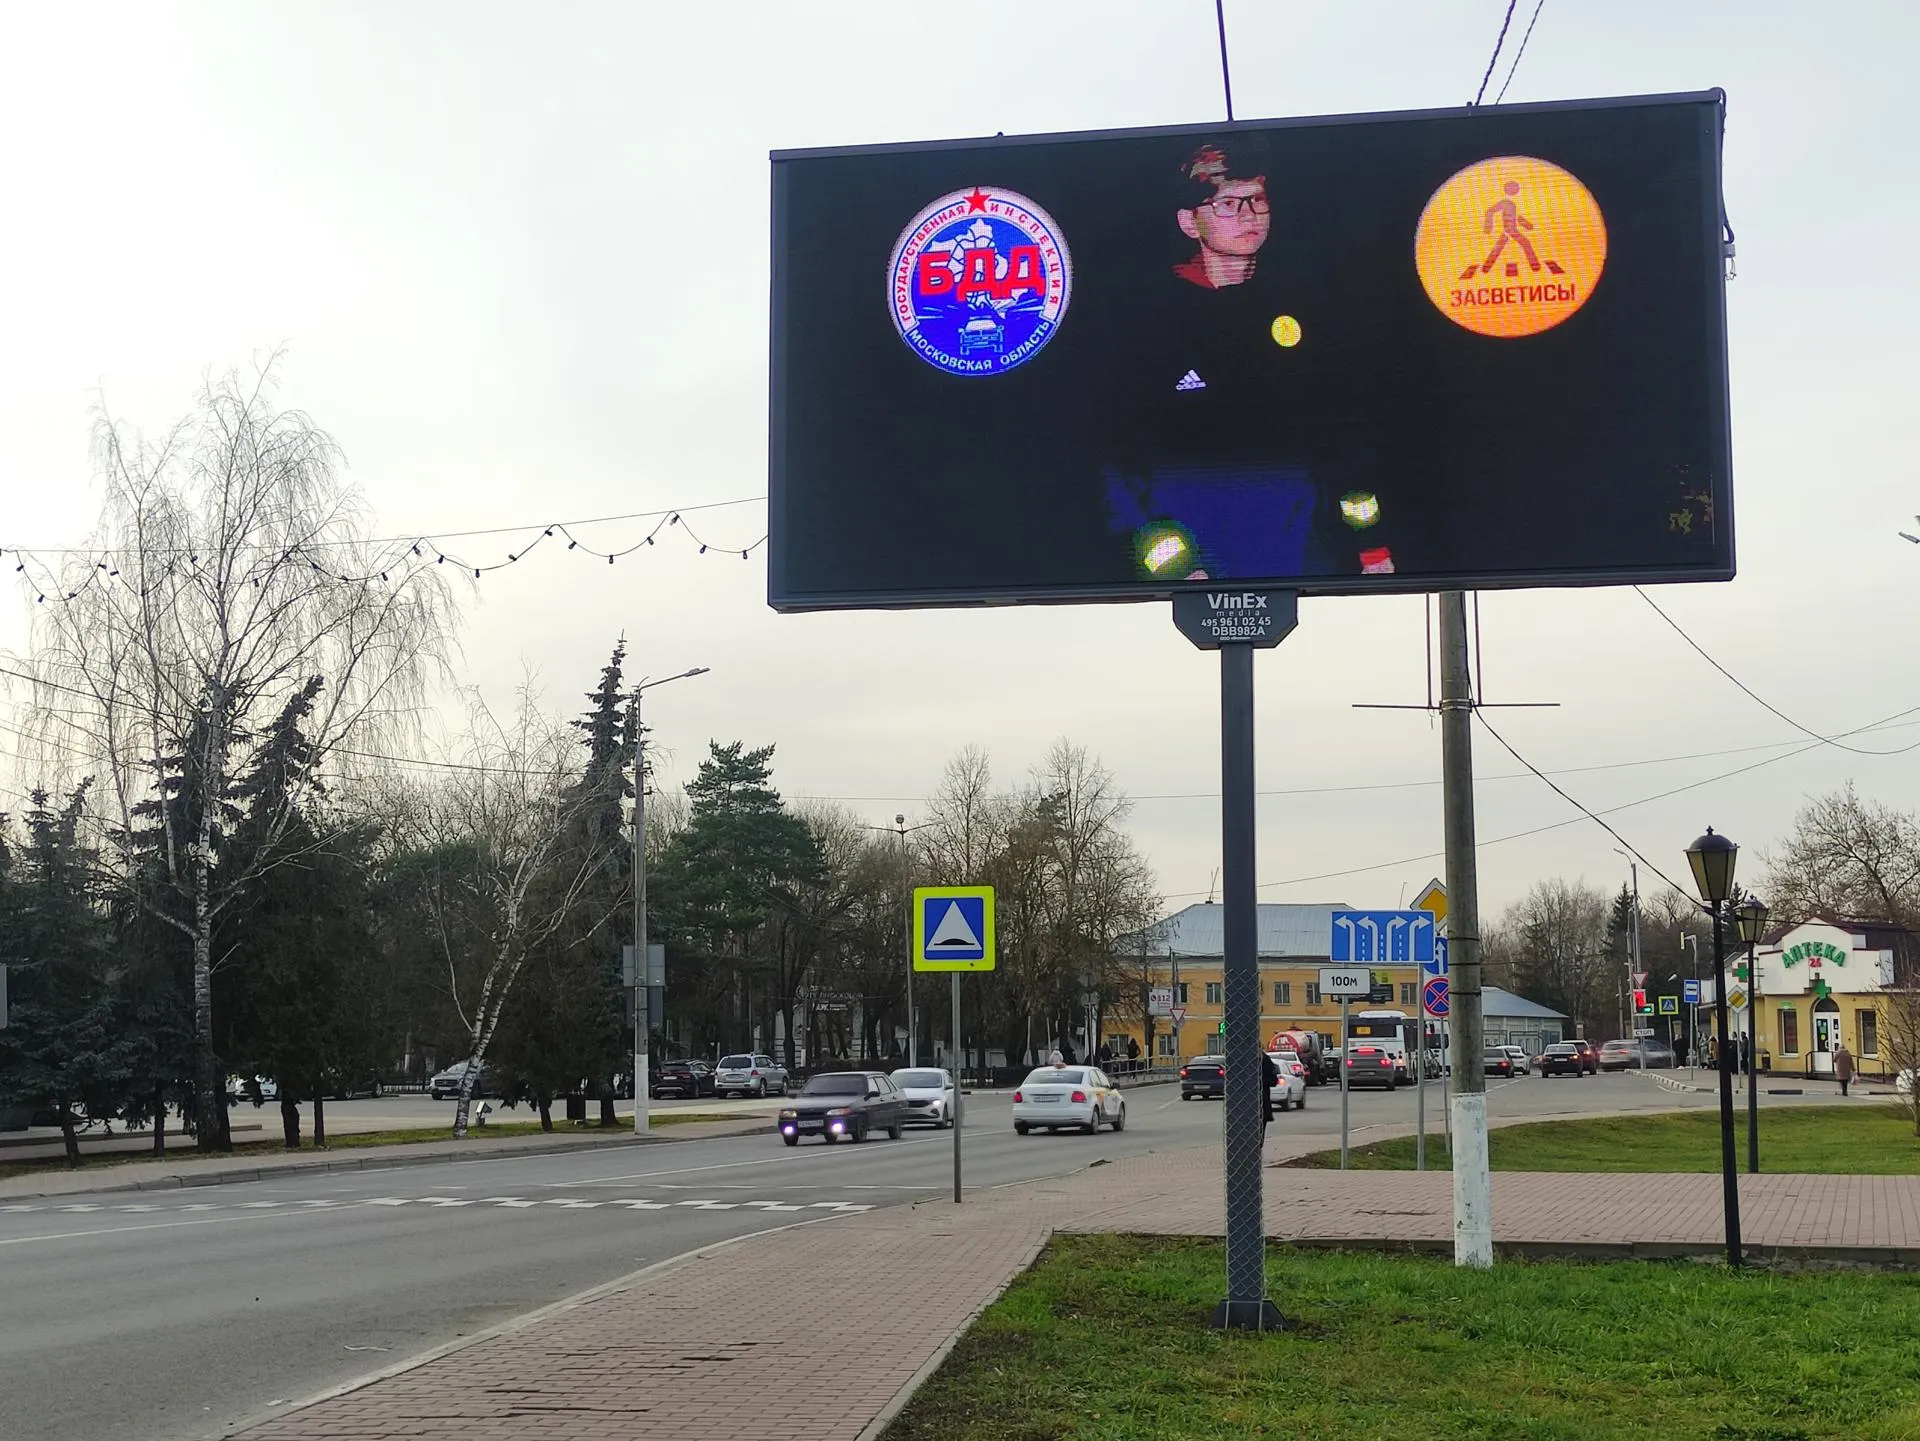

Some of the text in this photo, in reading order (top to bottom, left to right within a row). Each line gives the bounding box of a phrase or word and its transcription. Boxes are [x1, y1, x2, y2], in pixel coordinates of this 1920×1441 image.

[895, 203, 1063, 322] ГОСУДАРСТВЕННАЯ ИНСПЕКЦИЯ
[918, 245, 1045, 302] БДД
[908, 320, 1050, 370] МОСКОВСКАЯ ОБЛАСТЬ
[1207, 593, 1267, 609] VinEx
[1201, 616, 1271, 627] 495 961 02 45
[1212, 626, 1265, 636] DBB982A
[1781, 941, 1846, 968] АПТЕКА
